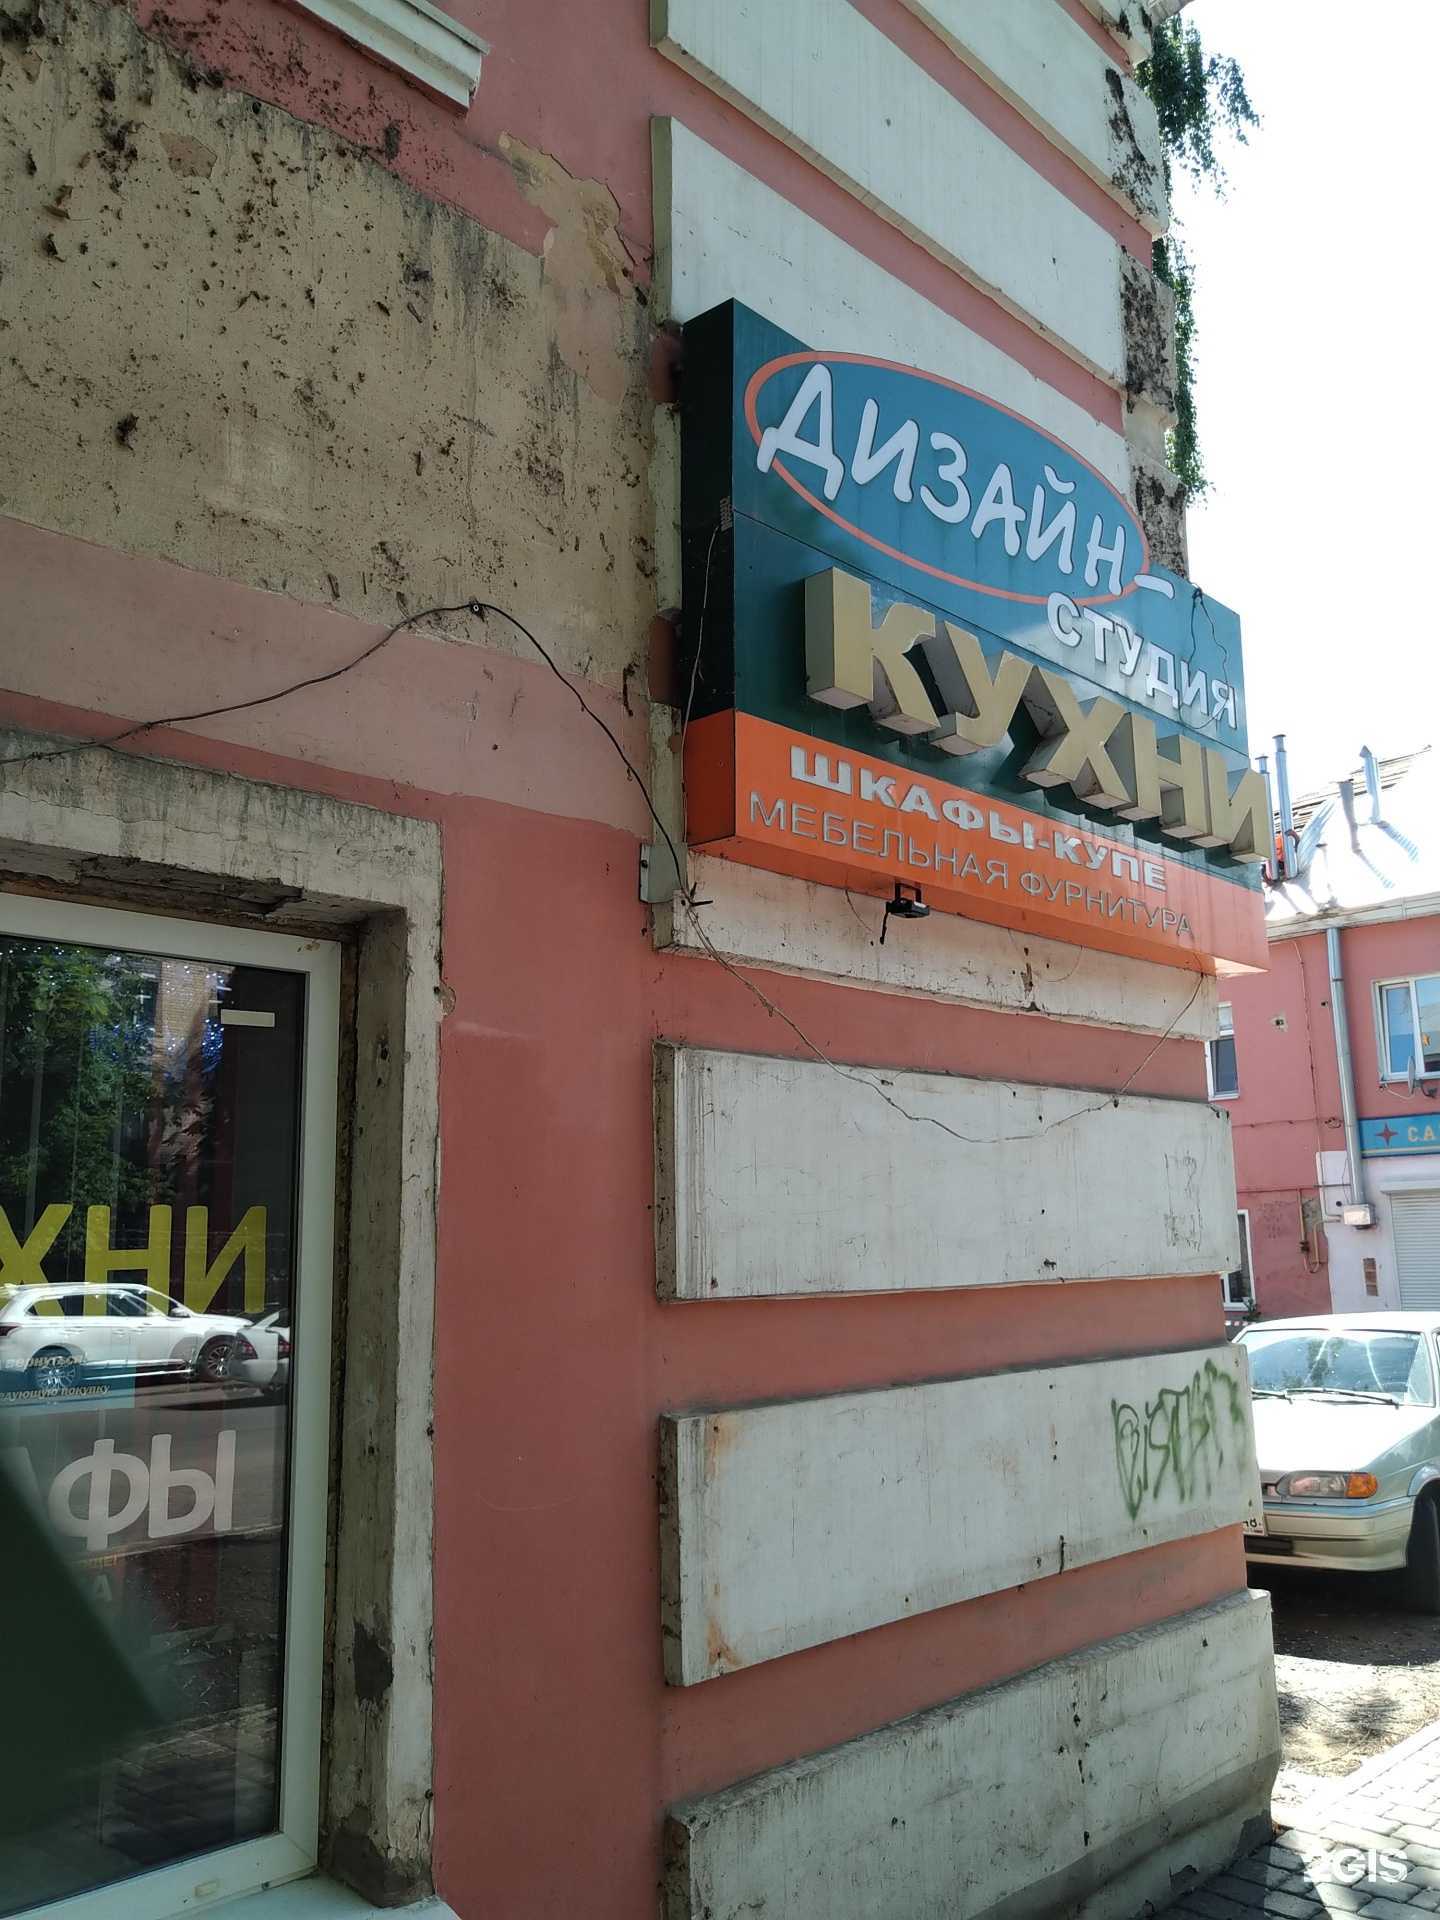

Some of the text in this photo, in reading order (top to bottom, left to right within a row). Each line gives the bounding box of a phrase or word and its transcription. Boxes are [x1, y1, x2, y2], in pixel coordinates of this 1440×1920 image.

[805, 567, 1272, 864] КУХНИ
[1047, 592, 1237, 729] СТУДИЯ
[749, 792, 1195, 938] МЕБЕЛЬНАЯ ФУРНИТУРА
[790, 745, 1167, 891] ШКАФЫ-КУПЕ
[1408, 1125, 1440, 1142] СА
